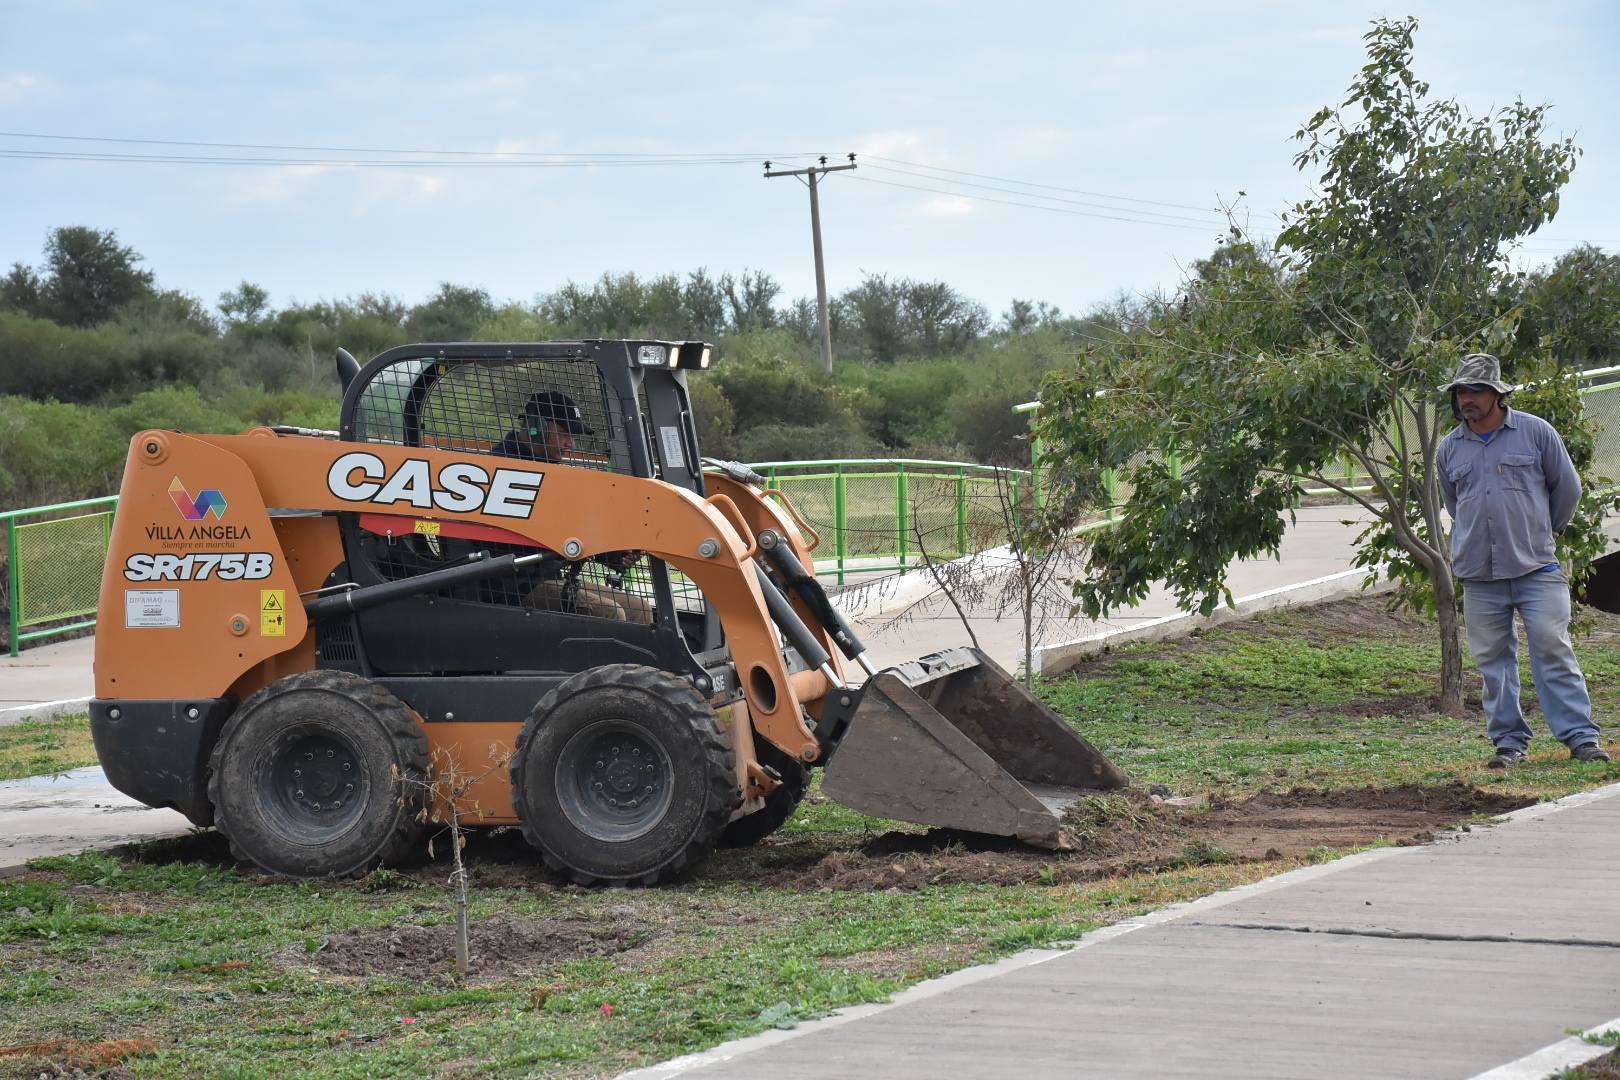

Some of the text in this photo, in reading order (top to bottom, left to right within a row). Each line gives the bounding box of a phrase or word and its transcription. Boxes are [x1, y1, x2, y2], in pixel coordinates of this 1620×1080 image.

[326, 451, 545, 519] CASE
[145, 523, 251, 540] VILLA ANGELA
[161, 540, 235, 550] Siempre en marcha
[123, 552, 274, 582] SR175B
